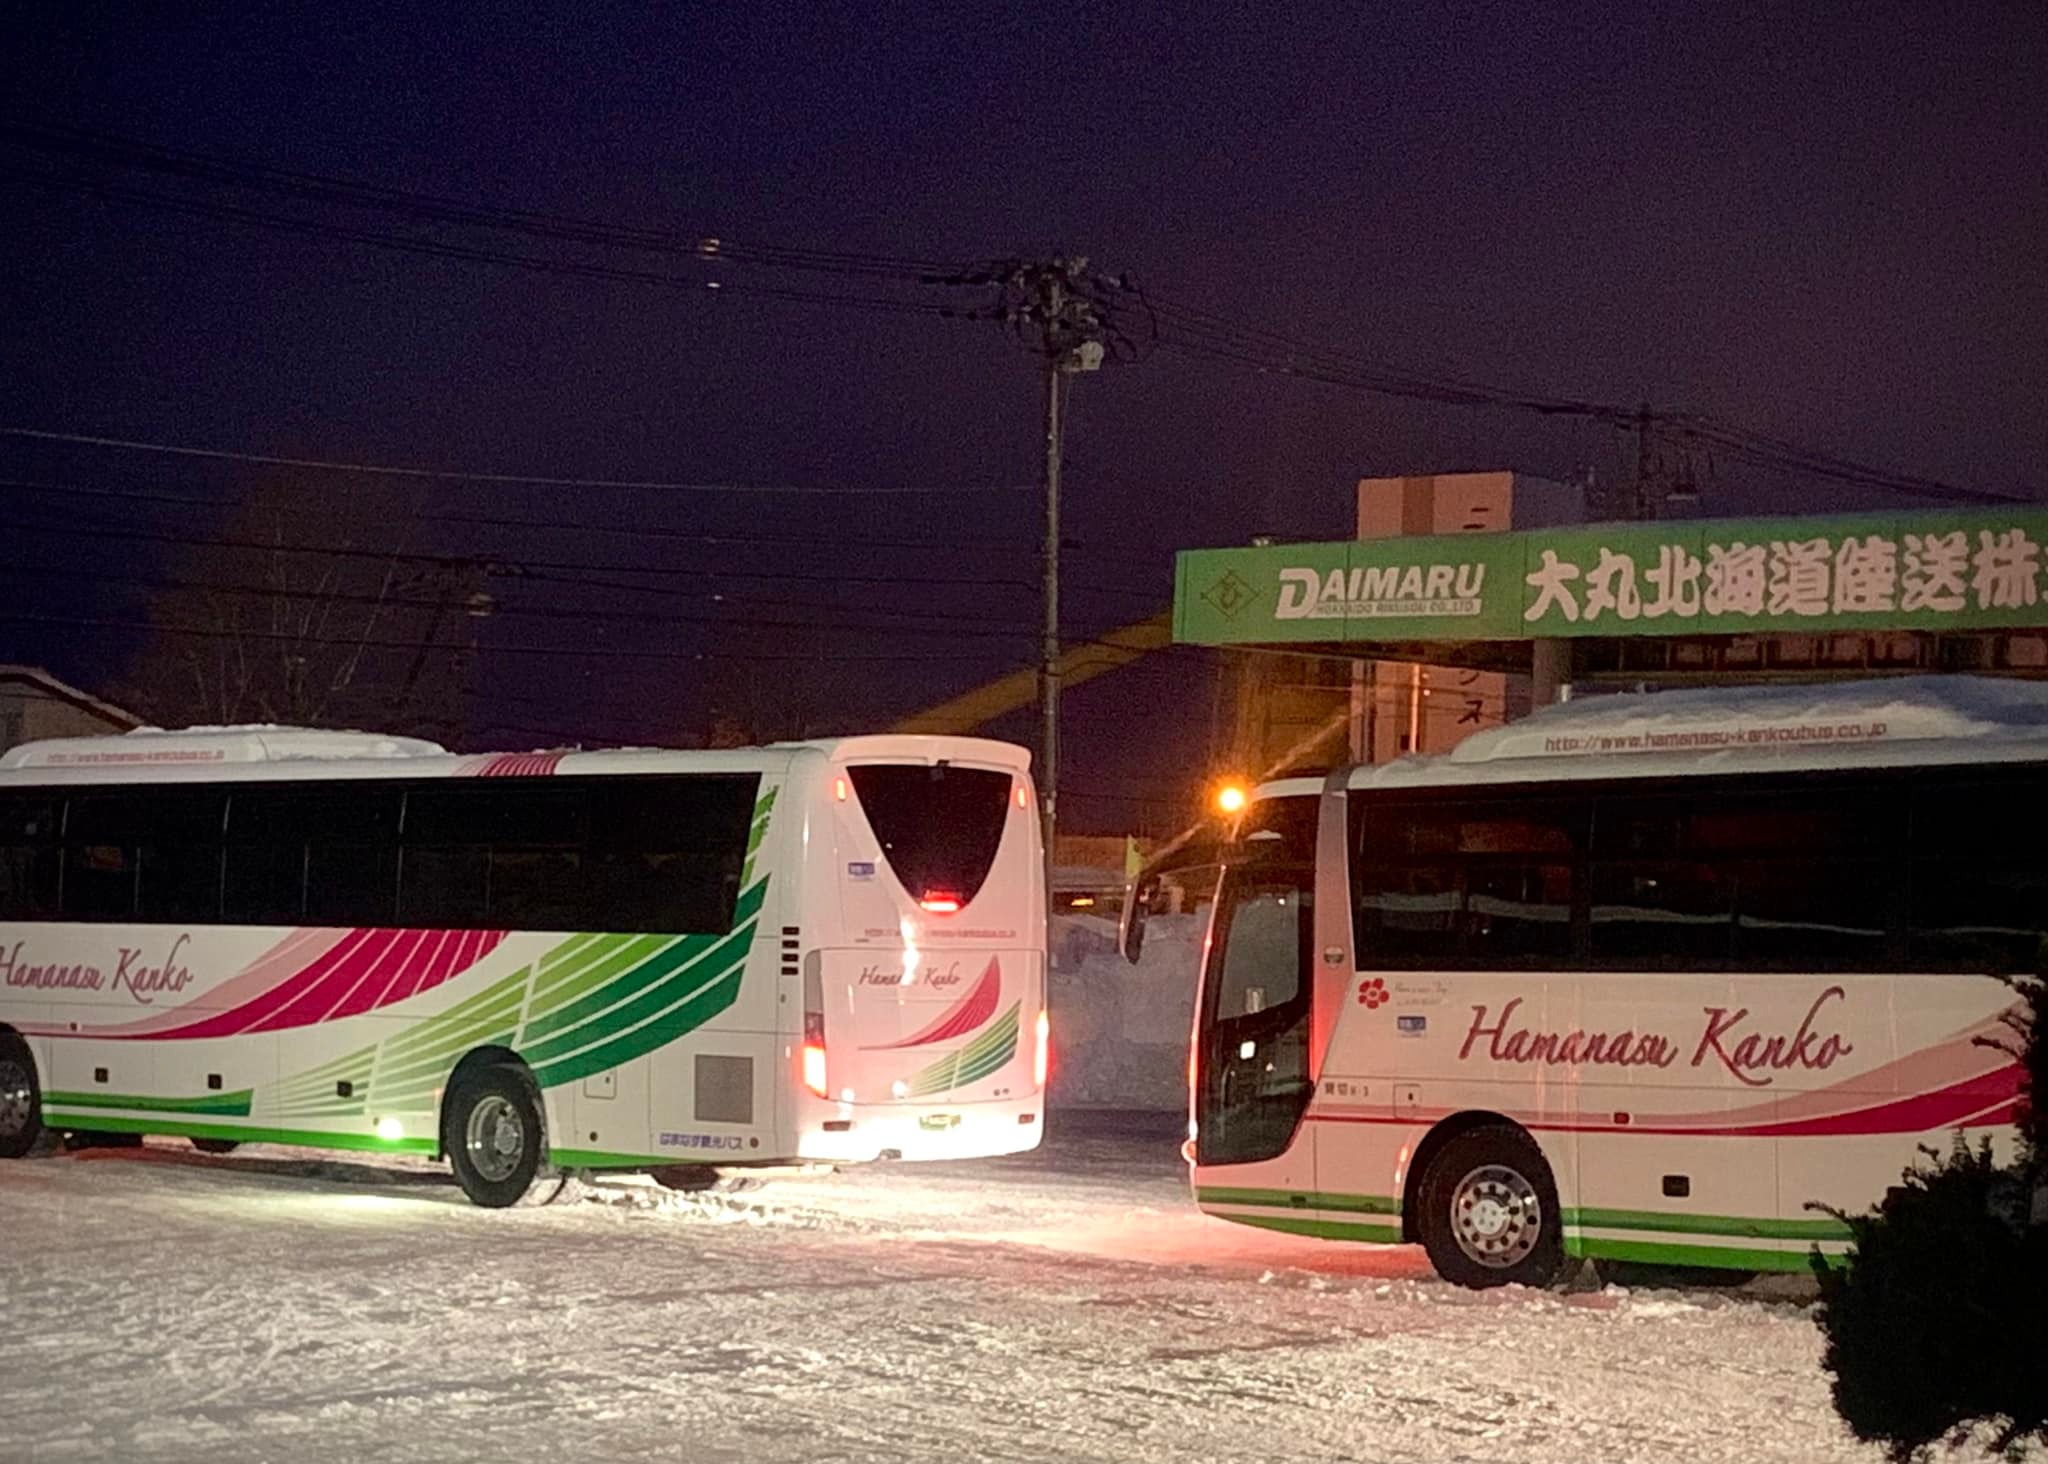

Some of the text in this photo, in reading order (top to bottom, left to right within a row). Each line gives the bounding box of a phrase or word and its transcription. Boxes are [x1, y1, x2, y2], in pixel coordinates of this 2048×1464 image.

[1275, 563, 1485, 619] DAIMARU
[111, 933, 194, 1005] Kanko
[1458, 986, 1853, 1085] Hamanasu Kanko
